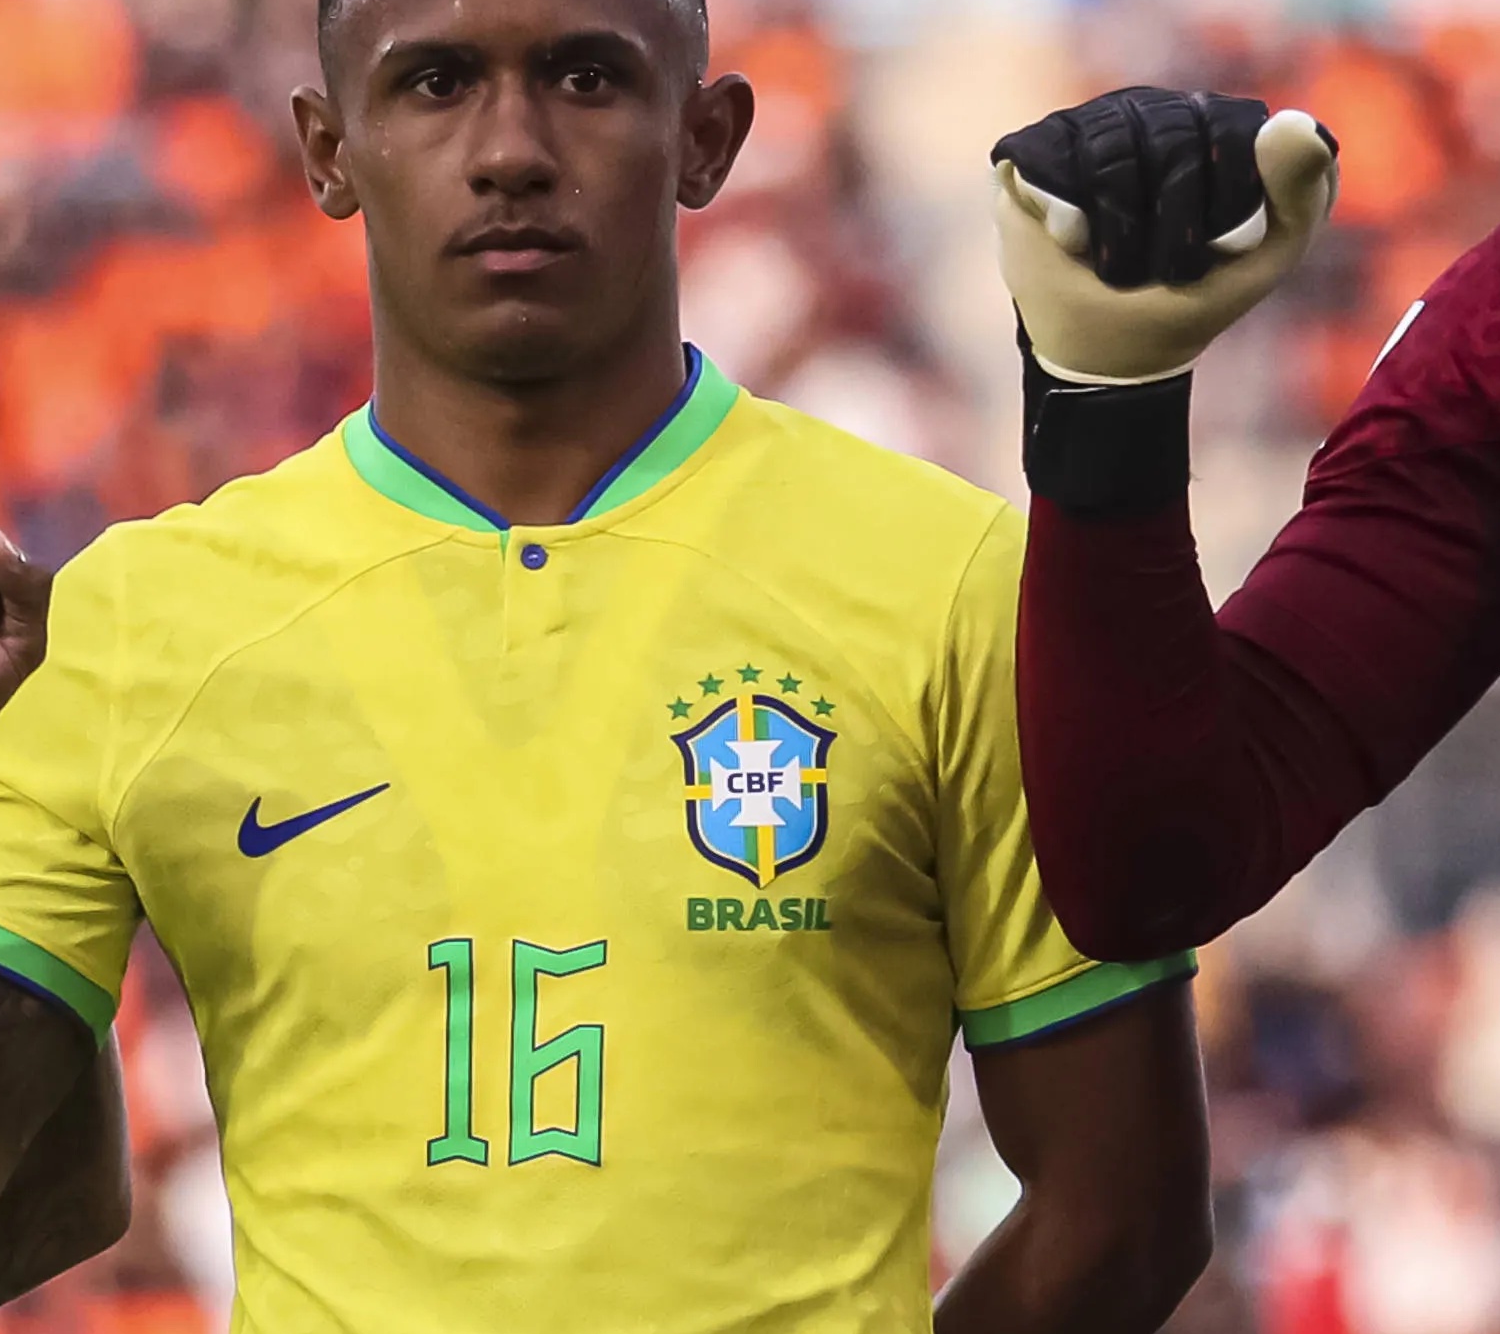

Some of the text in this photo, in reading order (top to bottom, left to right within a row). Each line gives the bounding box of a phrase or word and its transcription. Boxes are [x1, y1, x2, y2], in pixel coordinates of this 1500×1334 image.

[726, 770, 785, 794] CBF
[686, 897, 833, 932] BRASIL
[427, 938, 608, 1167] 16
